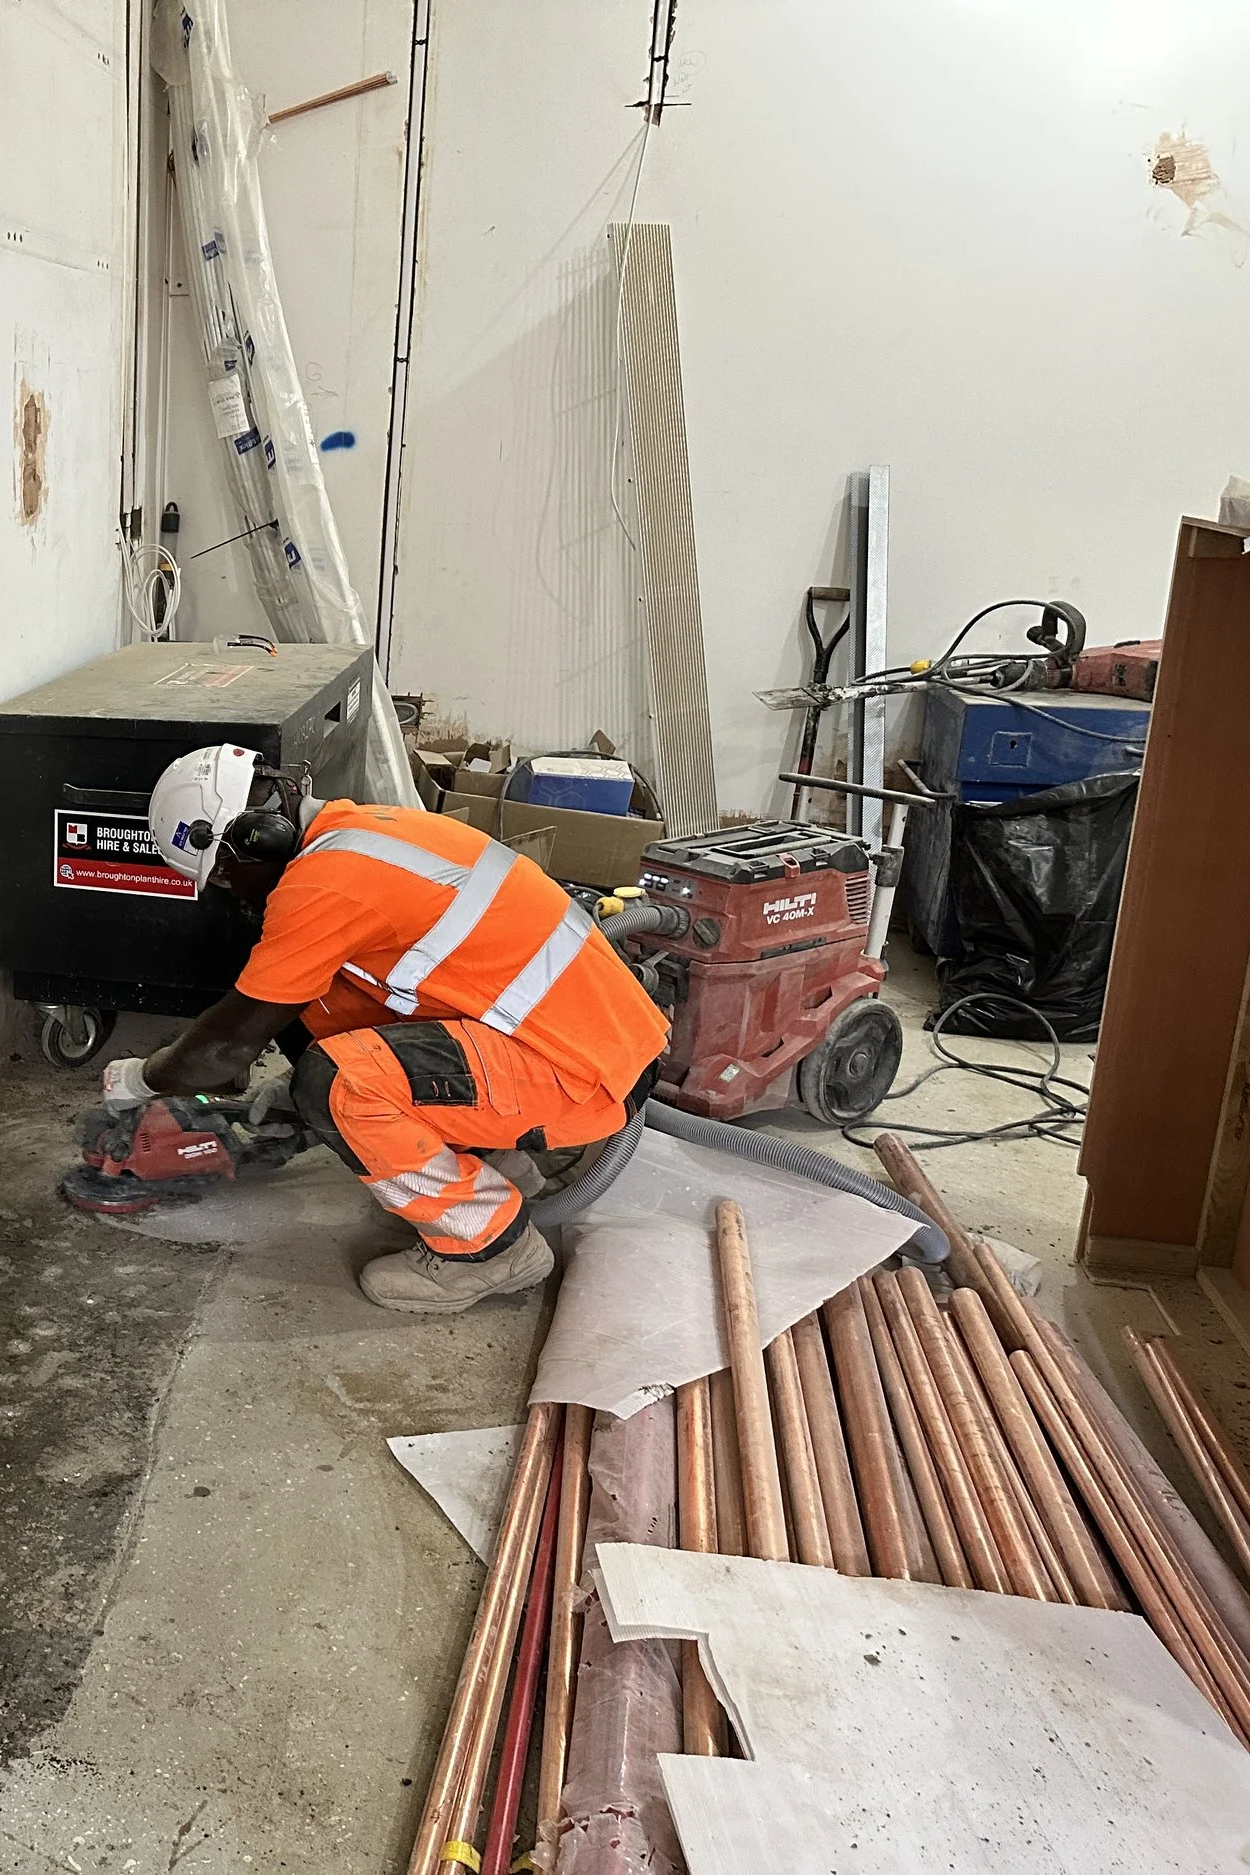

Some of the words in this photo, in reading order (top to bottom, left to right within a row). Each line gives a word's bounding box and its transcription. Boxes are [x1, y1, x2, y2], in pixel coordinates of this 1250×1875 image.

[97, 827, 154, 842] BROUGHTO
[97, 839, 120, 851] HIRE
[122, 841, 130, 852] &
[133, 842, 161, 855] SALE
[76, 869, 193, 887] www.broughtonplanthire.co.uk
[763, 892, 817, 915] HILTI
[766, 914, 781, 925] VC
[782, 907, 815, 921] 40M-X
